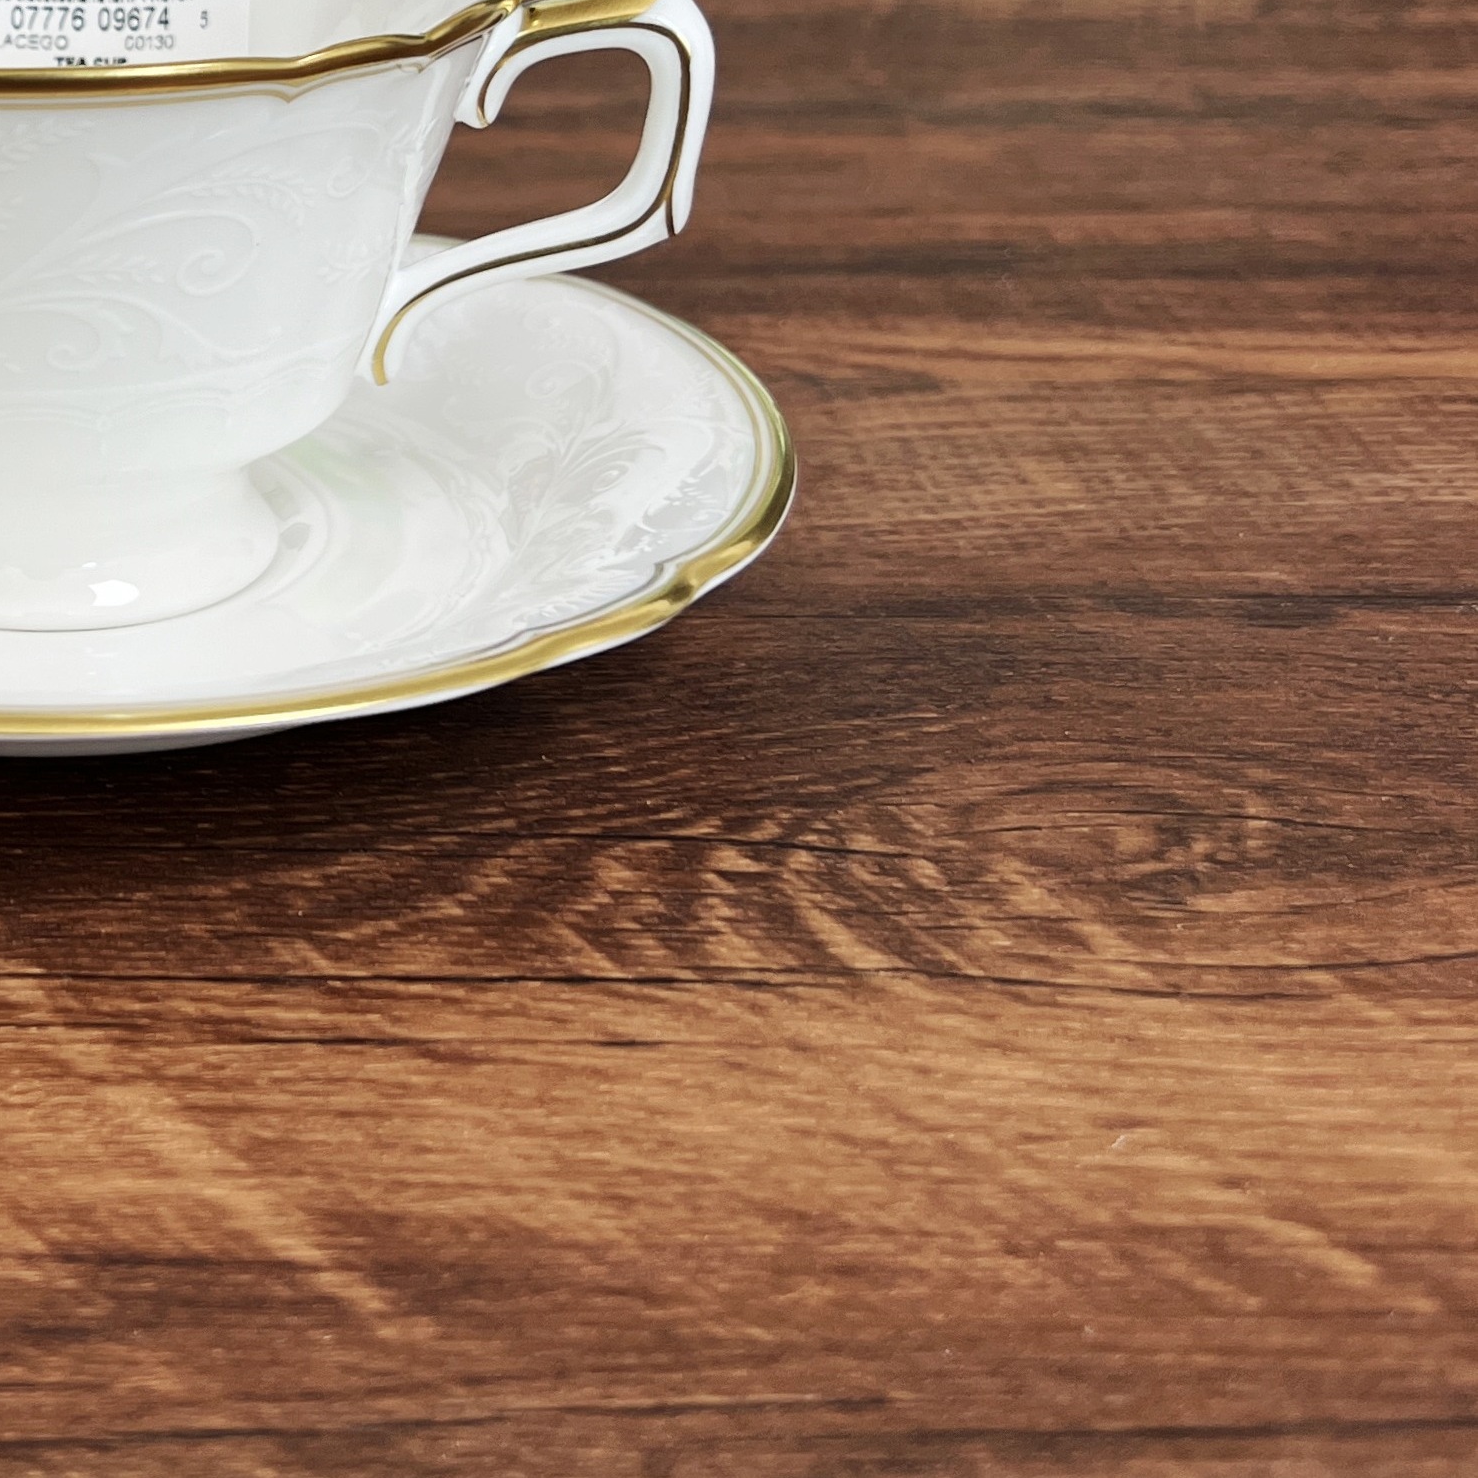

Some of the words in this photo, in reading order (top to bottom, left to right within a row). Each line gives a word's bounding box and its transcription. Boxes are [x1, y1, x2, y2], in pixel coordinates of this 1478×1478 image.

[10, 5, 84, 32] 07776
[97, 6, 170, 32] 09674
[199, 9, 209, 29] 5
